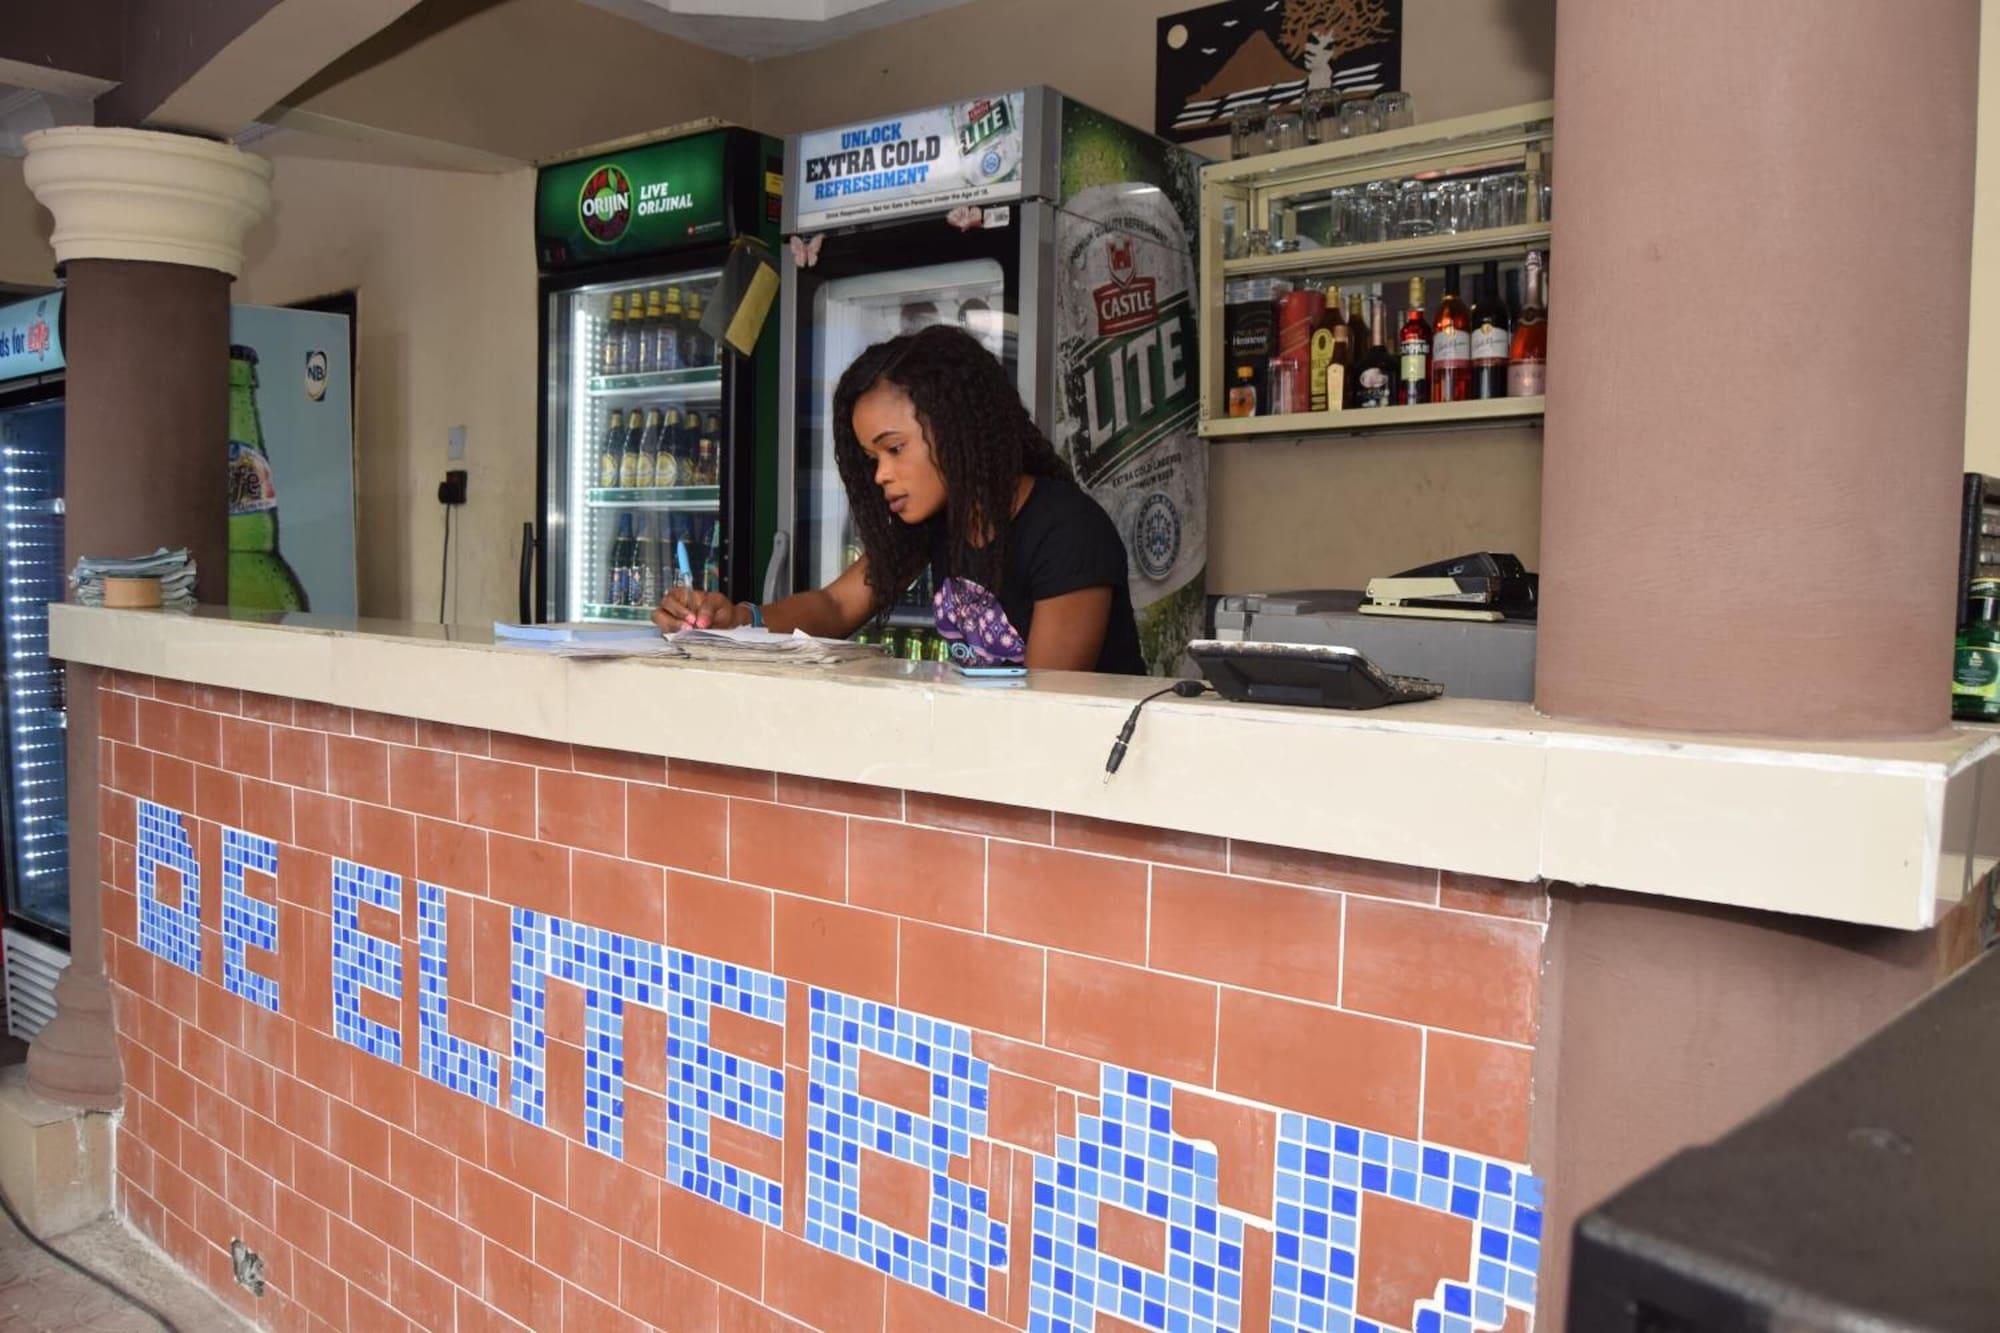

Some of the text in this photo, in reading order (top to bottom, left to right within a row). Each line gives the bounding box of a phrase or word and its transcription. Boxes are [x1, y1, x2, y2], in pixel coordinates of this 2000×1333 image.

[841, 122, 903, 150] UNLOCK
[964, 106, 1003, 149] LITE
[806, 135, 941, 183] EXTRA COLD
[640, 182, 669, 199] LIVE
[814, 165, 930, 200] REFRESHMENT
[582, 192, 630, 217] ORIJIN
[637, 194, 694, 217] ORIJINAL
[1100, 289, 1153, 321] CASTLE
[1083, 315, 1187, 454] LITE
[135, 797, 1544, 1333] DE ELITE BAR
